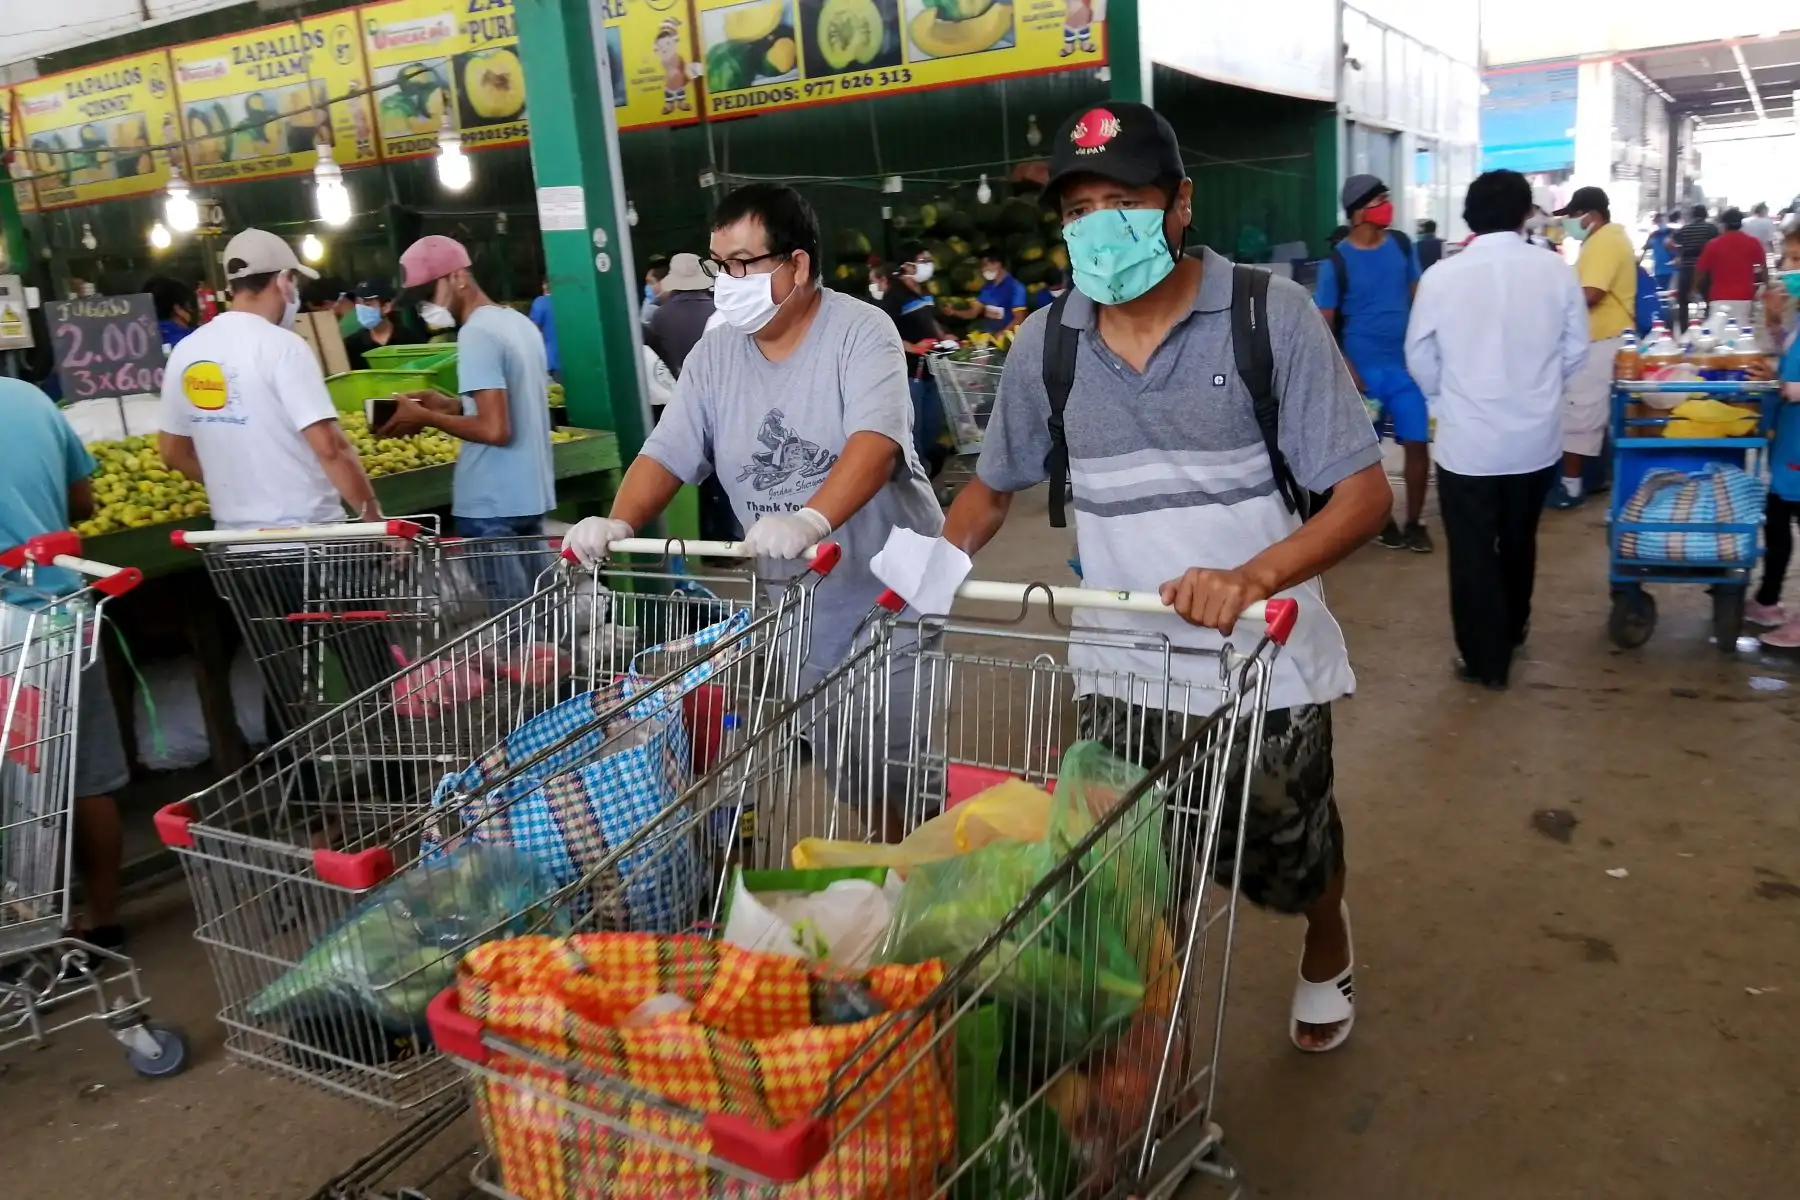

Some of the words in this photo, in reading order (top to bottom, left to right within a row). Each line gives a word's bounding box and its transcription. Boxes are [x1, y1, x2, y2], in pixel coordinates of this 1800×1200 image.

[231, 29, 325, 65] ZAPALLOS
[65, 66, 143, 98] ZAPALLOS
[714, 88, 799, 112] PEDIDOS:
[804, 79, 835, 97] 977
[841, 74, 873, 90] 626
[879, 68, 912, 86] 313
[1075, 144, 1106, 155] JAPAN
[57, 321, 148, 368] 2.00
[747, 501, 781, 513] Thank
